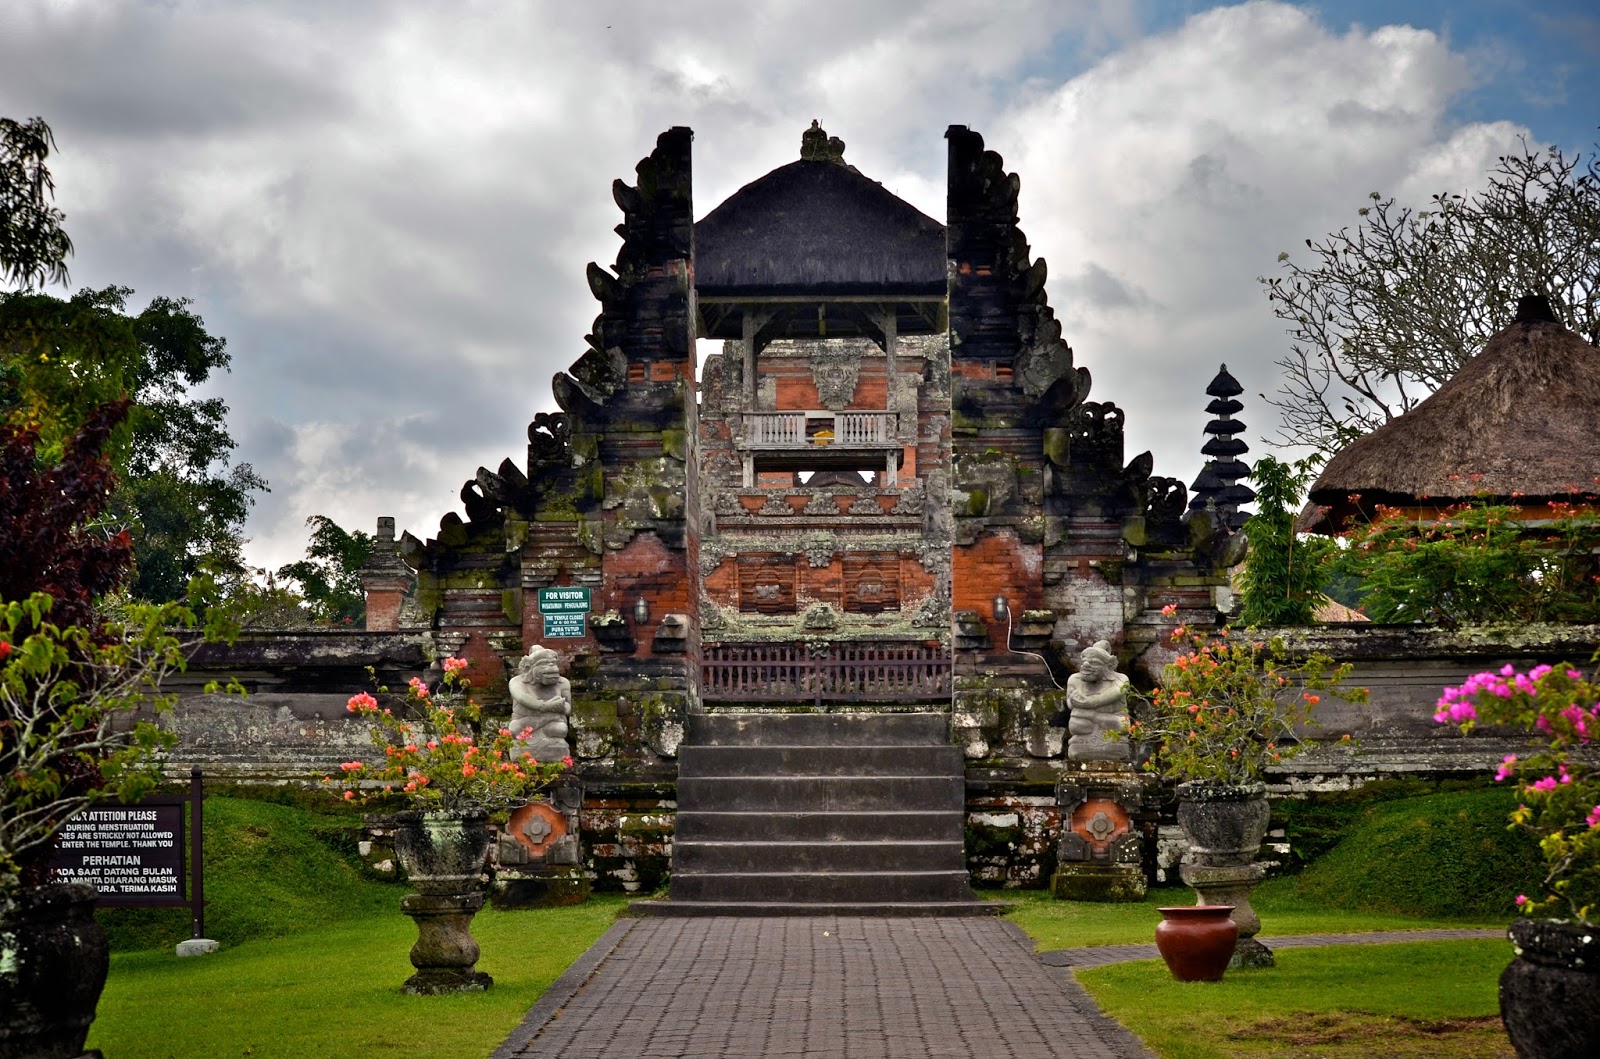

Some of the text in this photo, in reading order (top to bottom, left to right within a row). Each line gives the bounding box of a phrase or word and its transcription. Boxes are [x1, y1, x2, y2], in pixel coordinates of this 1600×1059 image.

[88, 811, 126, 821] ATTETION
[128, 811, 157, 820] PLEASE
[82, 856, 141, 866] PERHATIAN
